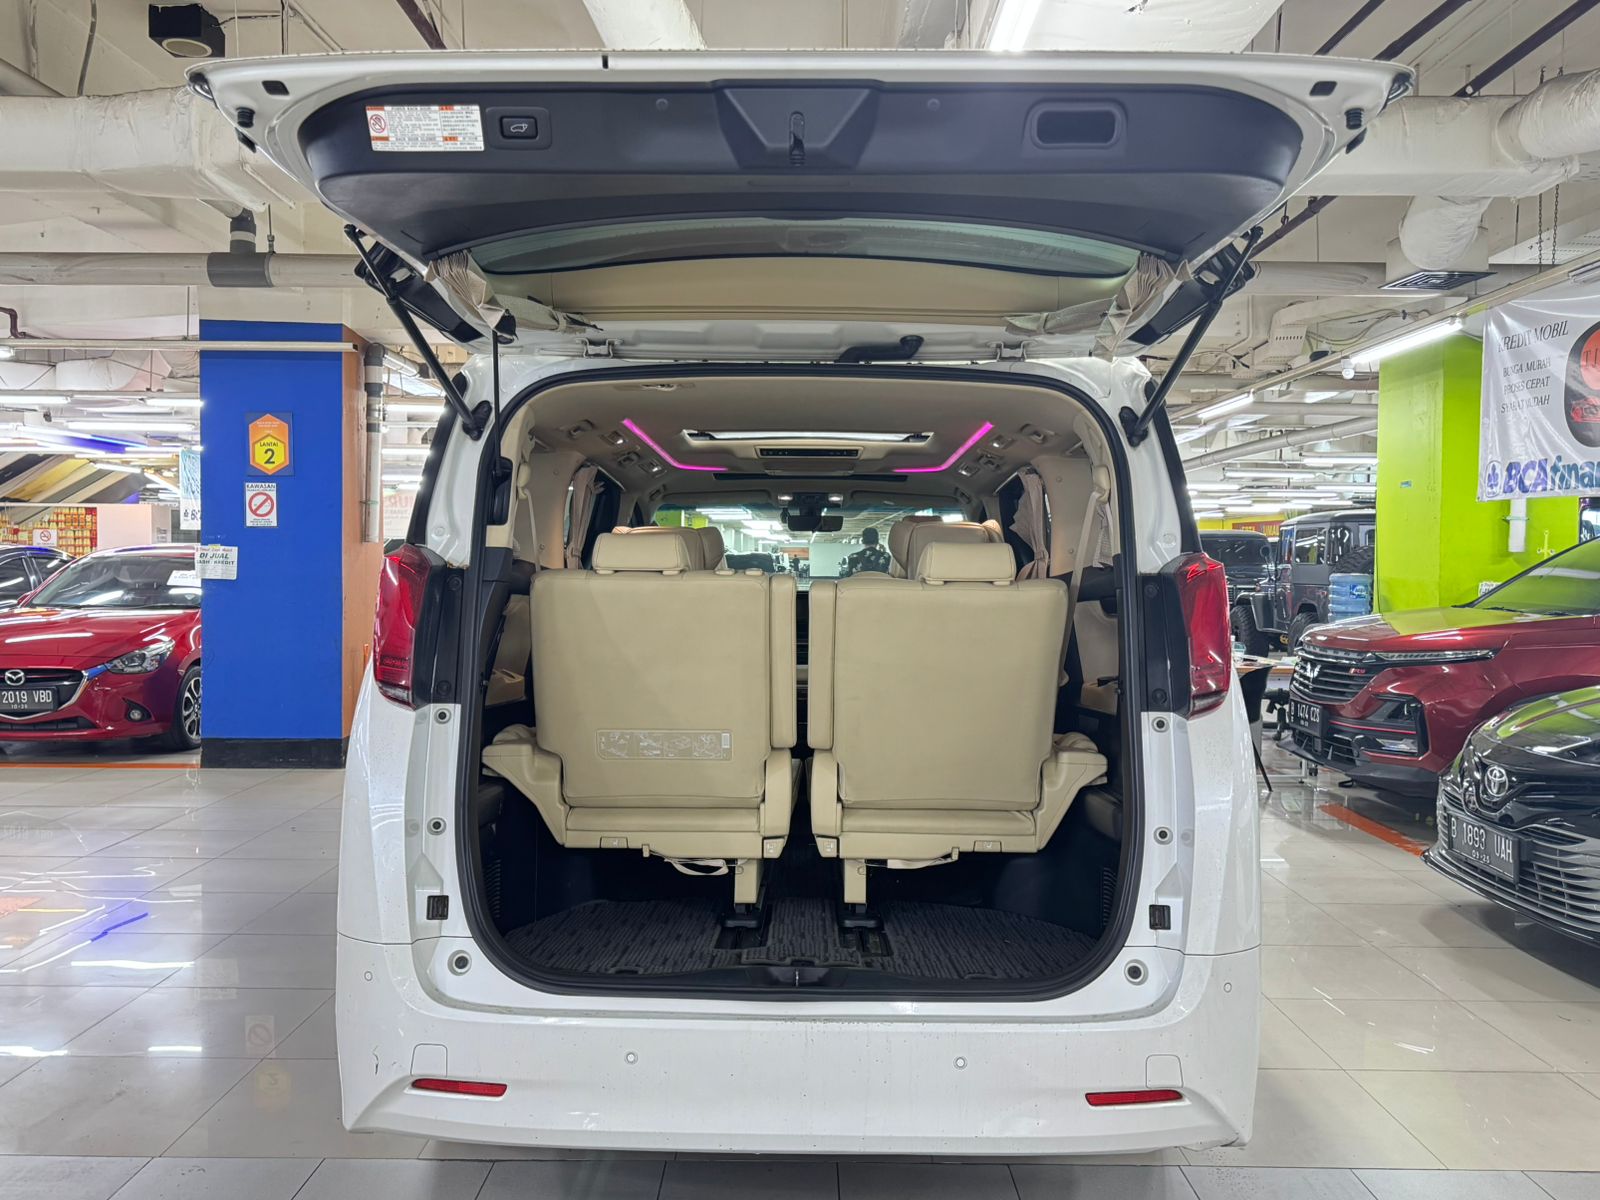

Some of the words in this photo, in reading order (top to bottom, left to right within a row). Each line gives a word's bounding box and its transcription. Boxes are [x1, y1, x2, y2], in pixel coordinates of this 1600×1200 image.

[1498, 329, 1531, 352] KREDIT
[1534, 320, 1569, 342] MOBIL
[1503, 363, 1524, 377] BUNGA
[1525, 357, 1551, 373] MURAH
[1503, 381, 1525, 395] PROSES
[1525, 376, 1551, 390] CEPAT
[1524, 394, 1550, 409] MUDAH
[264, 448, 275, 464] 2
[1, 691, 28, 703] 2019
[32, 690, 52, 702] VBD
[1297, 704, 1309, 719] 1474
[1451, 817, 1457, 838] B
[1462, 822, 1486, 850] 1893
[1494, 834, 1513, 863] UAH
